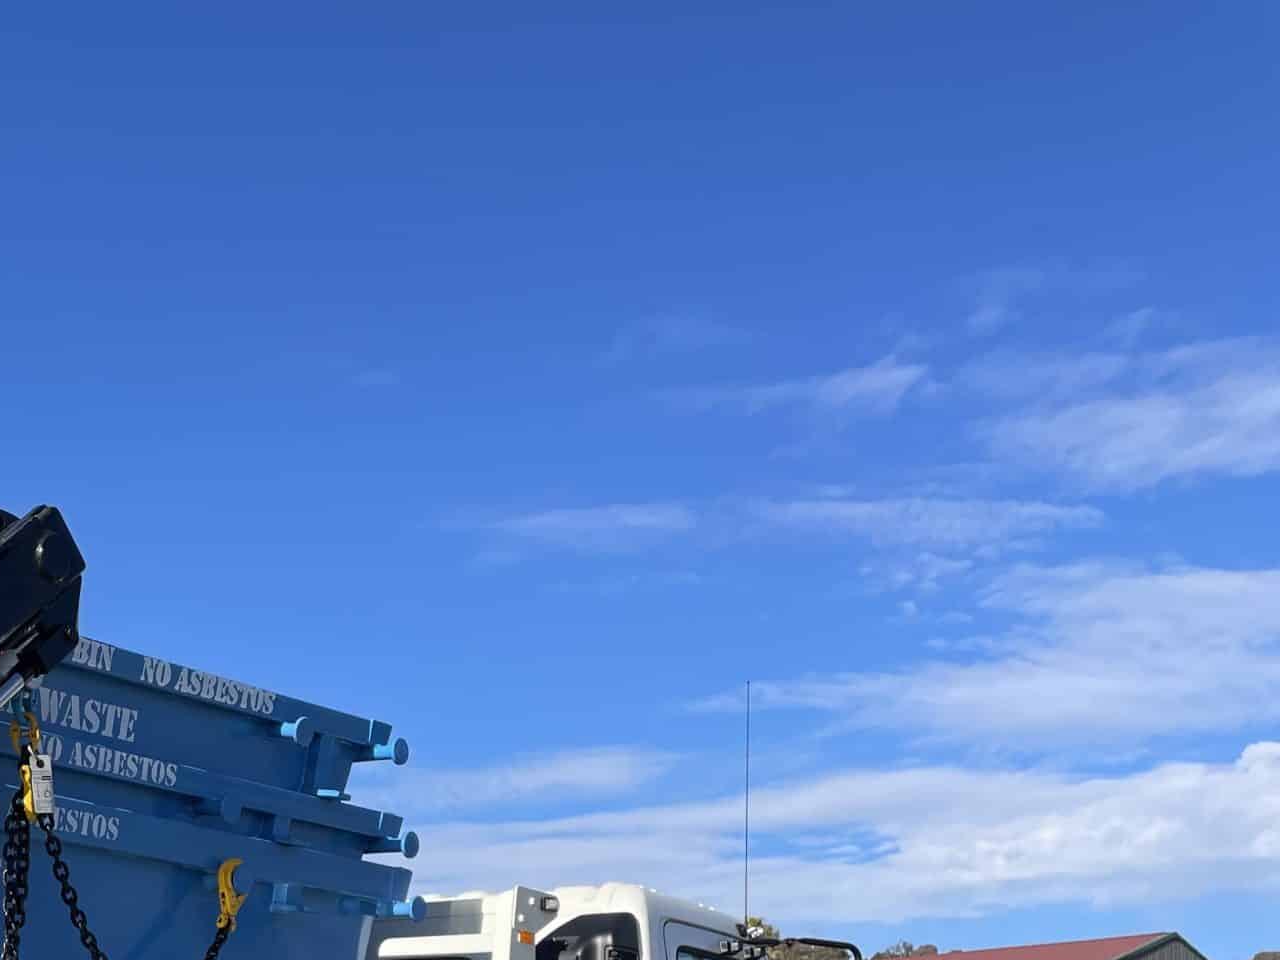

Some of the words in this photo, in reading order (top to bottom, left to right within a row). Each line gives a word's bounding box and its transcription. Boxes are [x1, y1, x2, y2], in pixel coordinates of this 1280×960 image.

[72, 637, 115, 672] BIN
[140, 656, 171, 687] NO
[174, 668, 276, 714] ASBESTOS
[38, 687, 138, 742] WASTE
[68, 741, 177, 787] ASBESTOS
